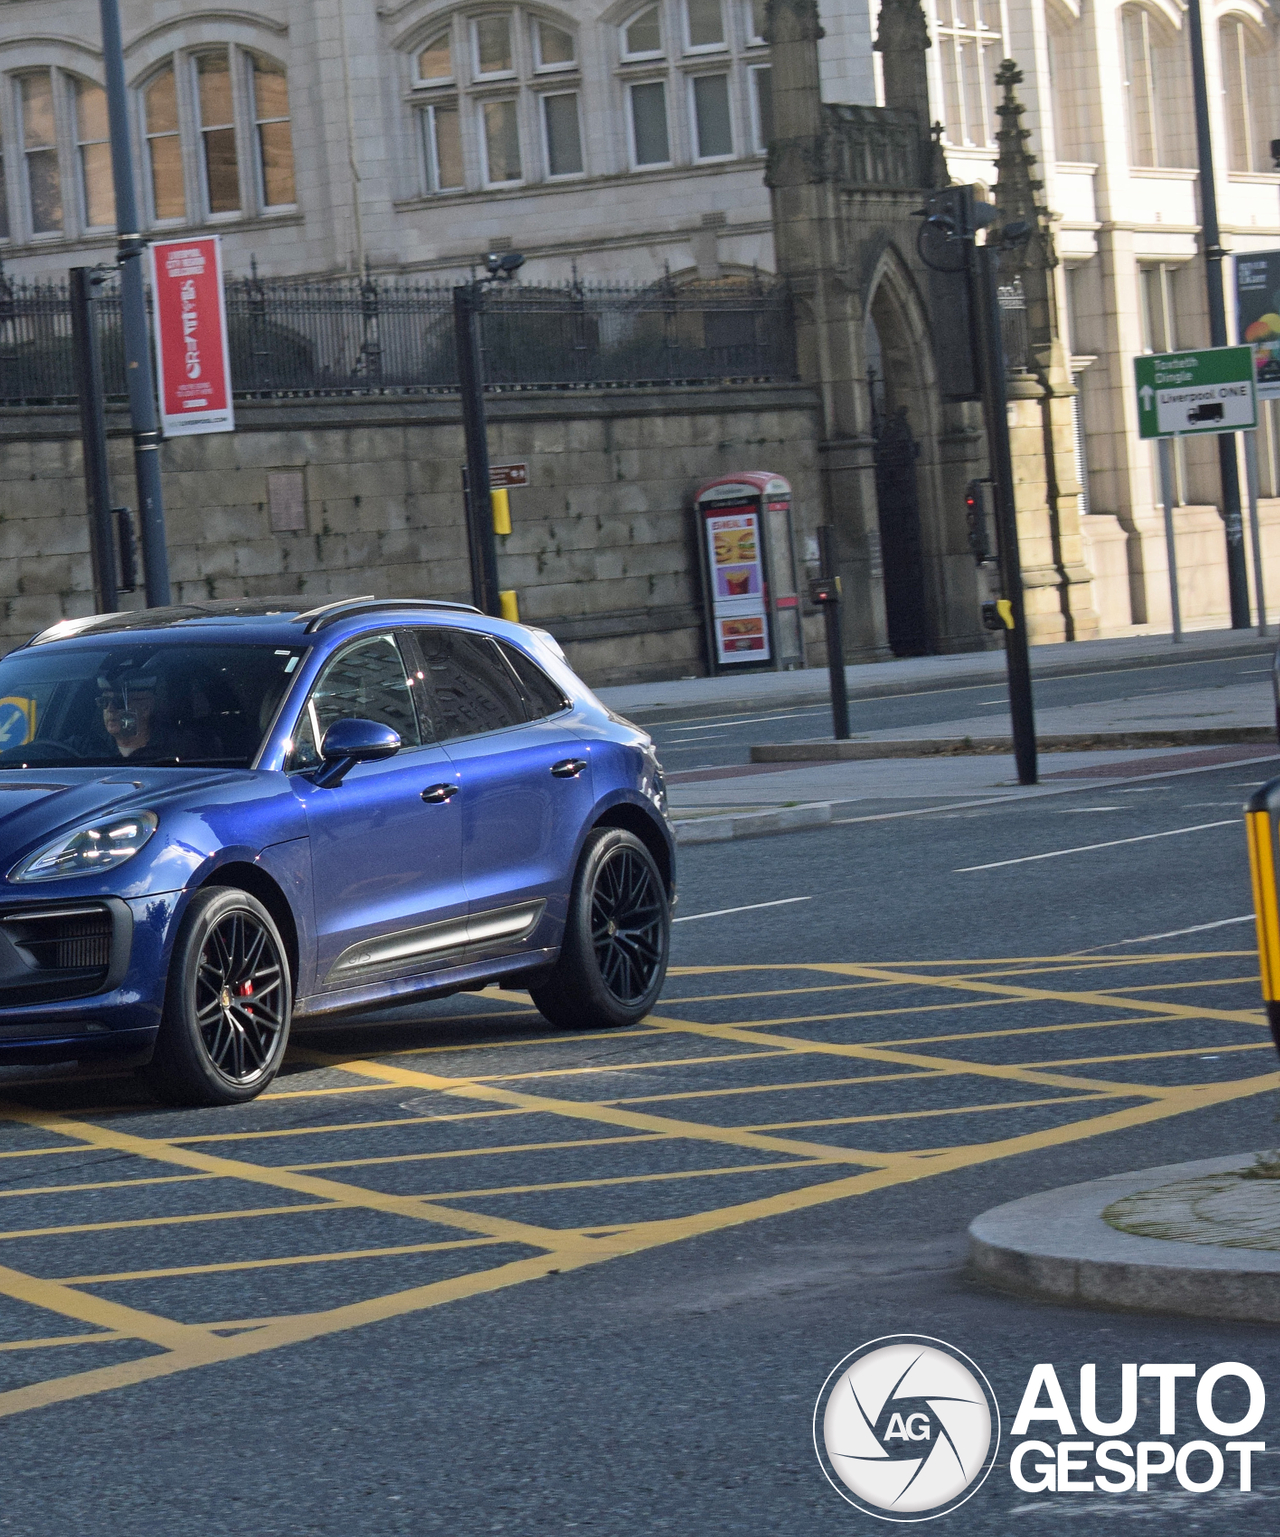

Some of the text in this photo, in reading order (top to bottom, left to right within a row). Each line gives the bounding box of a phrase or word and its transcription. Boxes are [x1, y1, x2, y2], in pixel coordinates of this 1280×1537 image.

[1154, 371, 1194, 384] Dingle
[1160, 386, 1247, 404] Liverpool ONE
